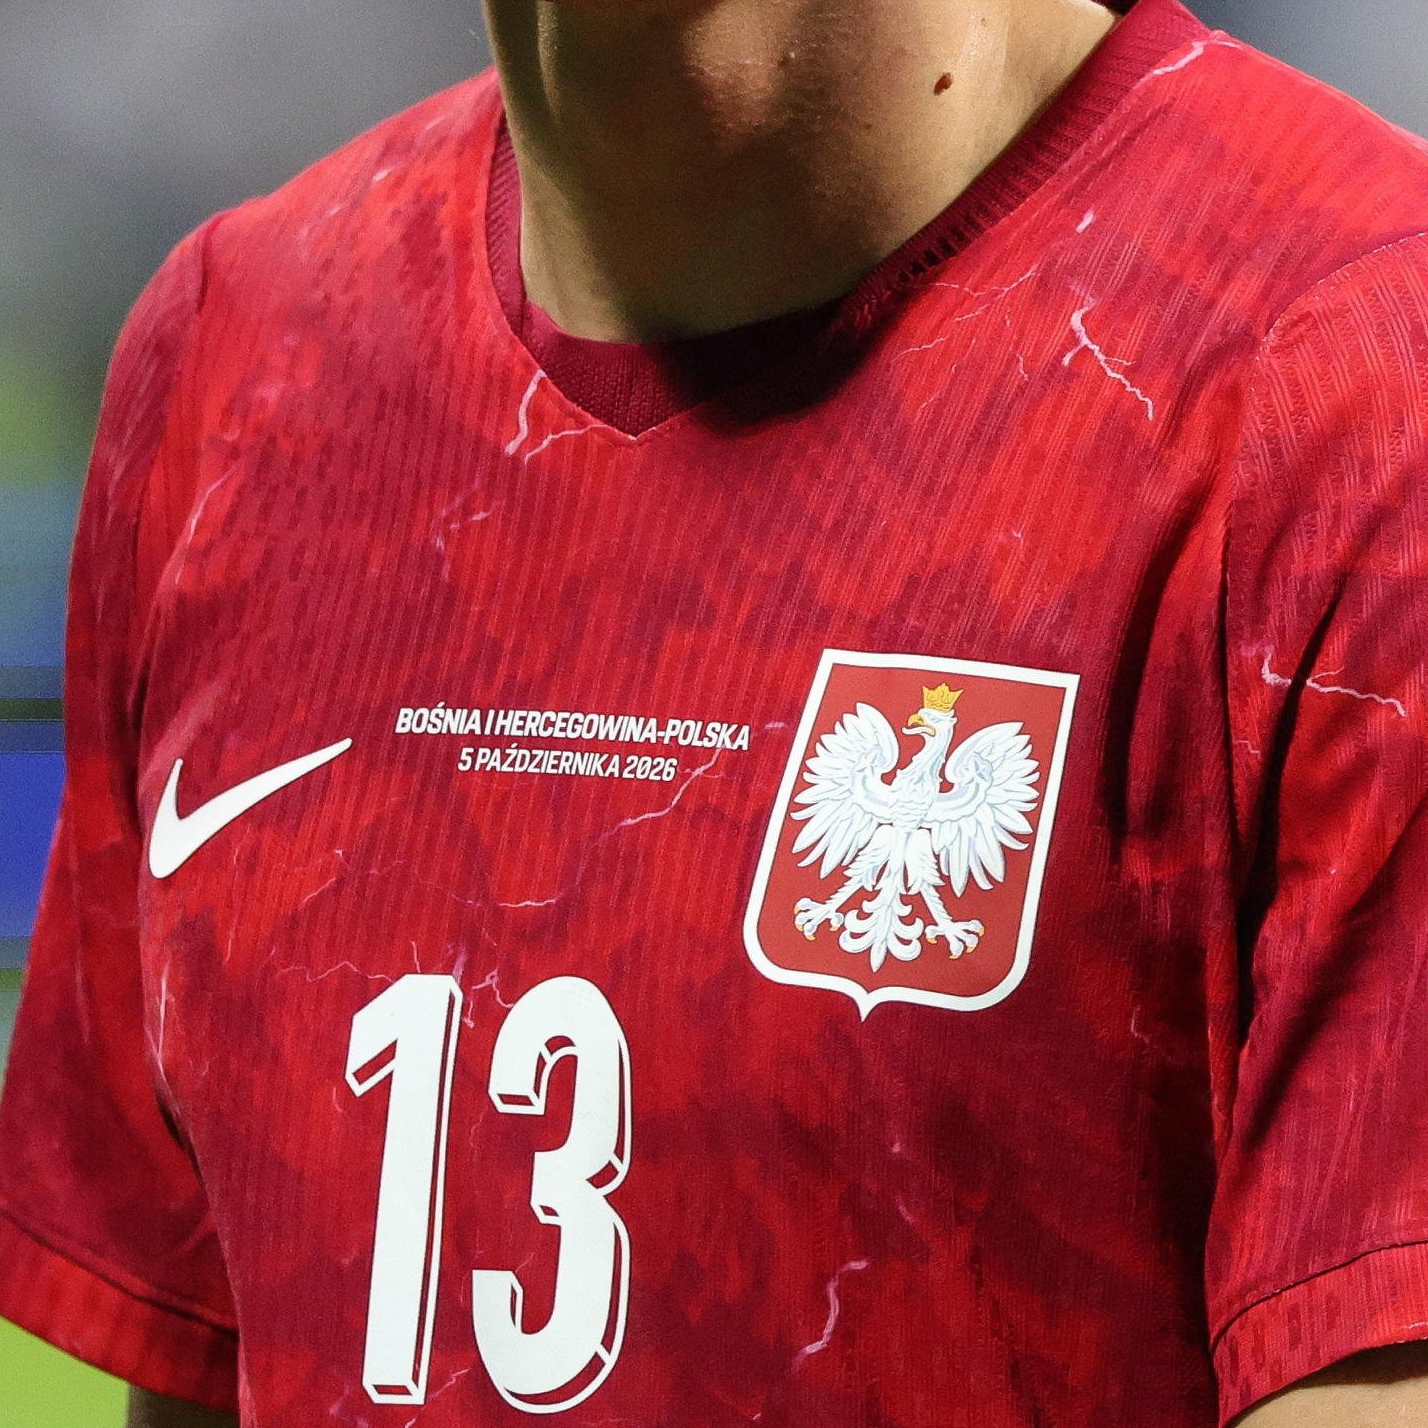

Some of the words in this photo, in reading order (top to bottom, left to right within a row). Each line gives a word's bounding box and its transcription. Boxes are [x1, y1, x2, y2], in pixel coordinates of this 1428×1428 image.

[395, 701, 482, 735] BOŚNIA
[484, 709, 496, 736] I
[494, 709, 750, 751] HERCEGOWINA-POLSKA
[457, 747, 475, 772] 5
[474, 742, 621, 778] PAŹDZIERNIKA
[622, 755, 678, 782] 2026
[345, 973, 632, 1414] 13
